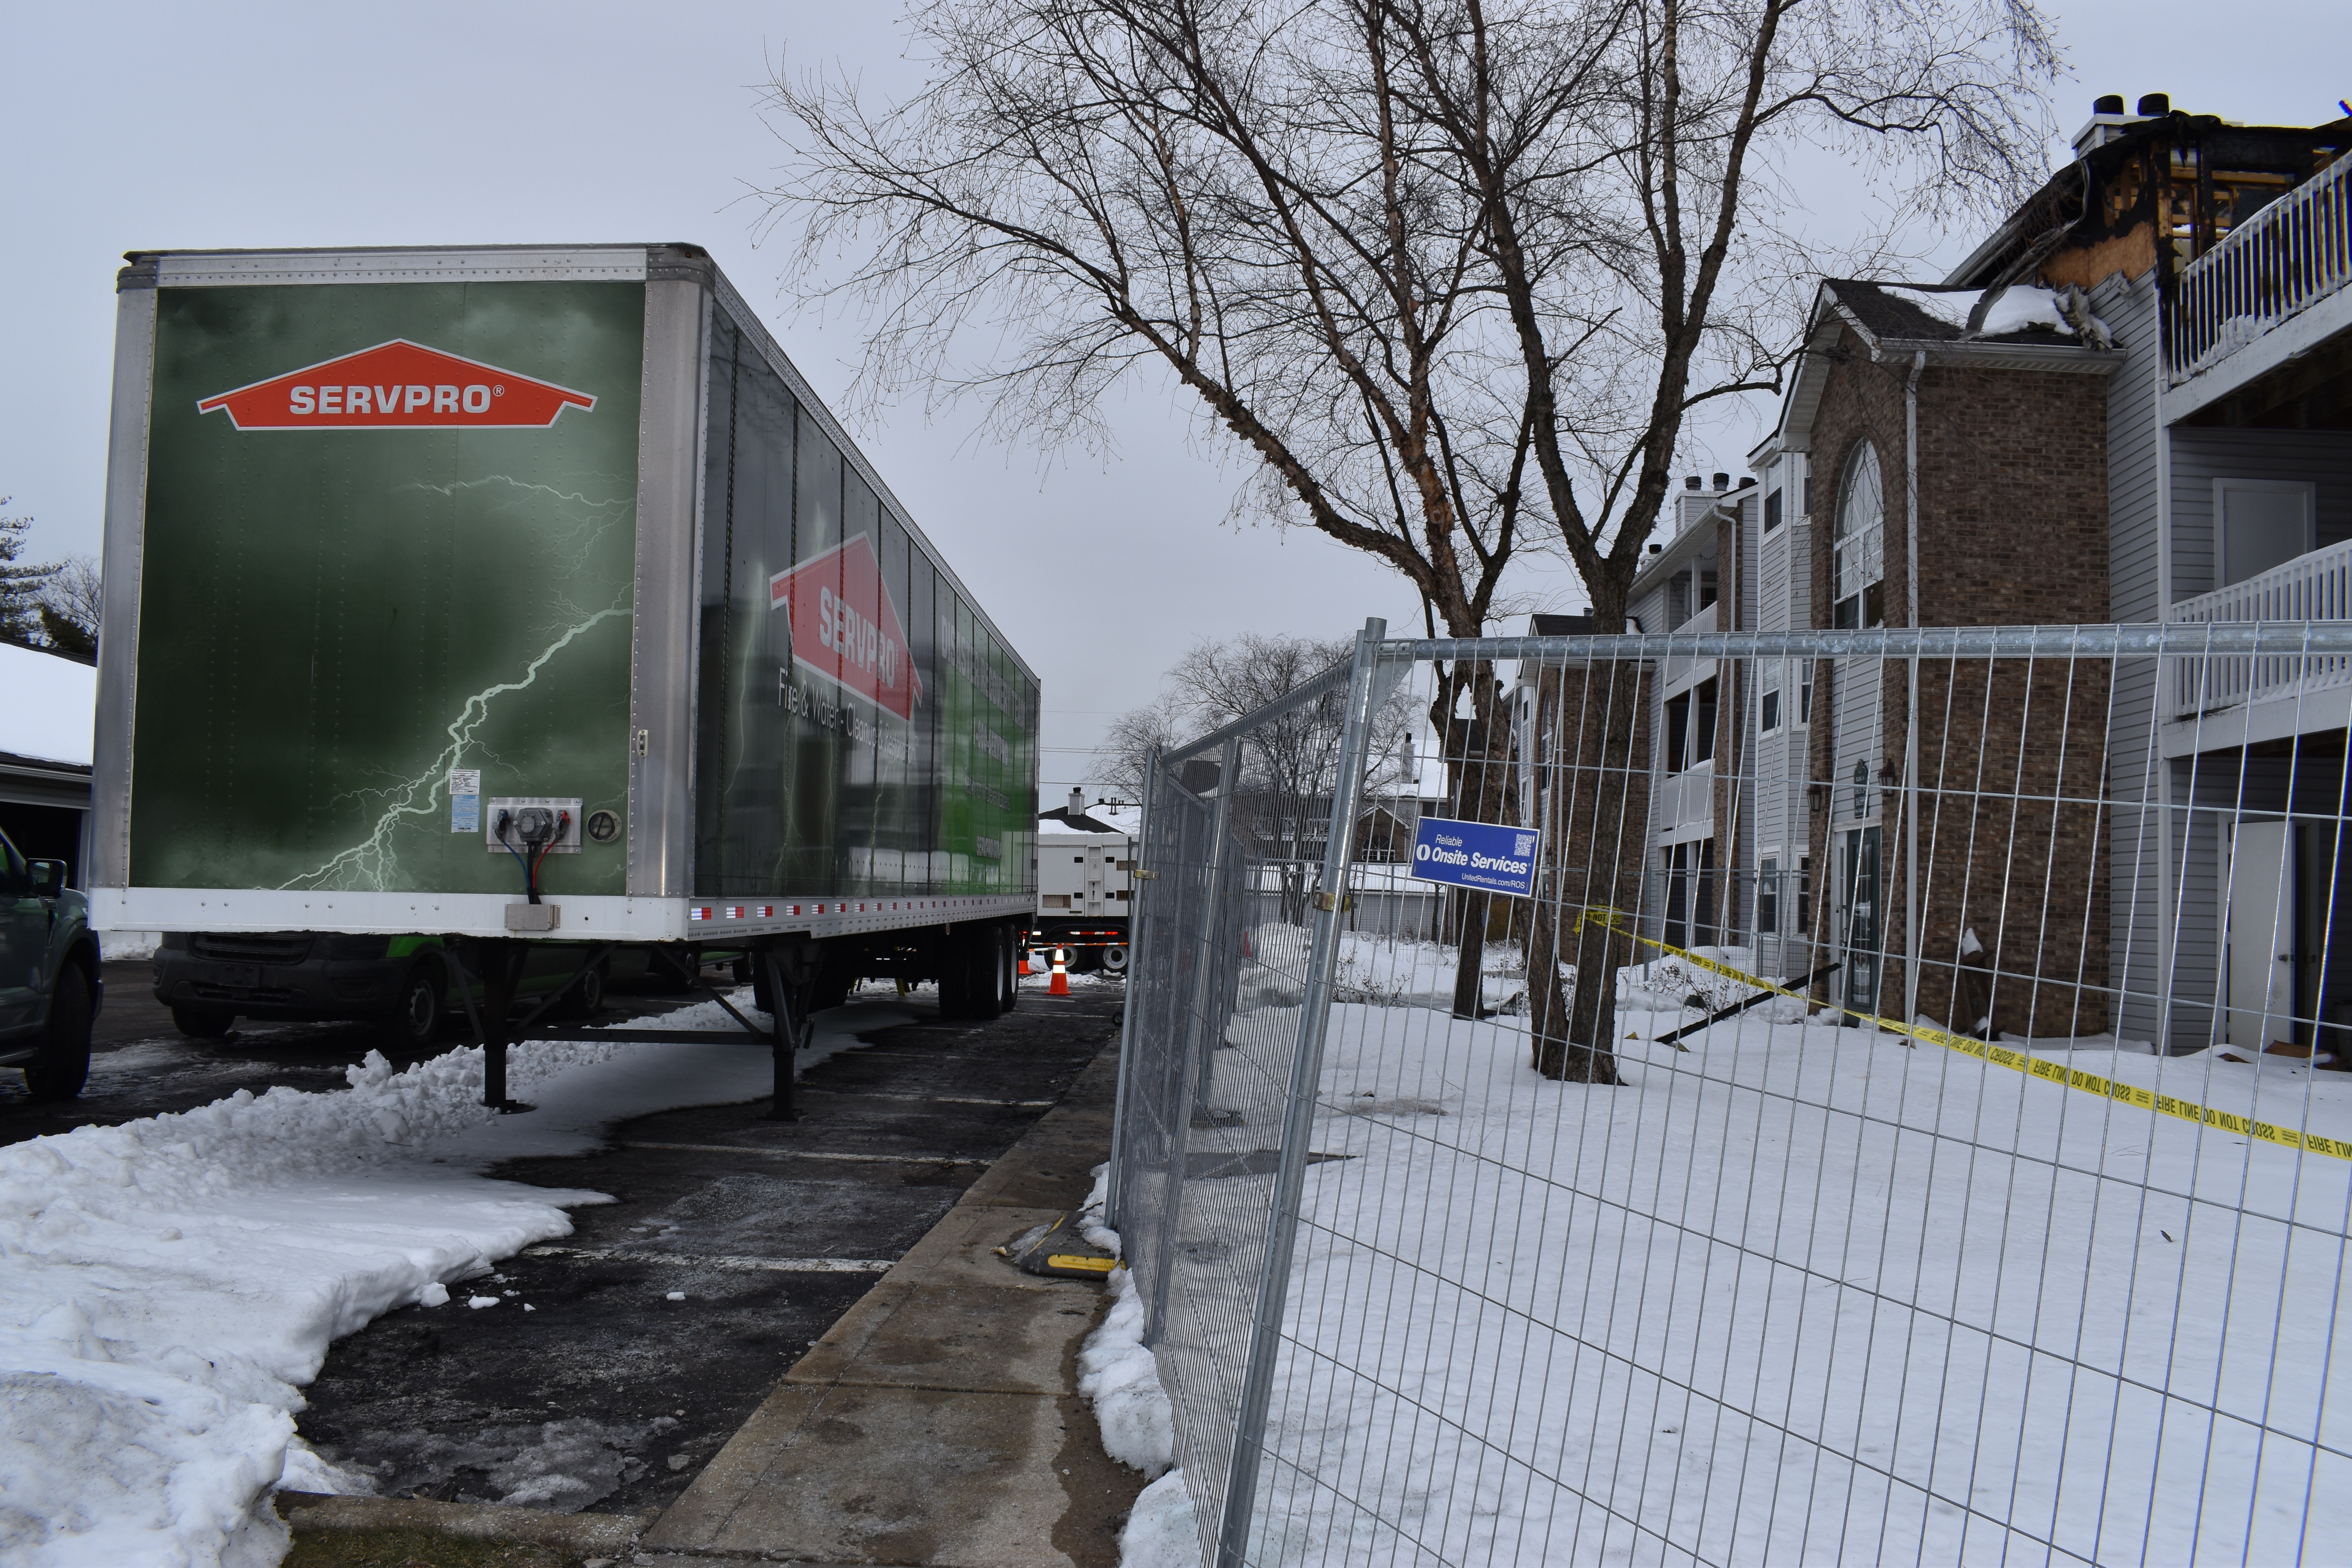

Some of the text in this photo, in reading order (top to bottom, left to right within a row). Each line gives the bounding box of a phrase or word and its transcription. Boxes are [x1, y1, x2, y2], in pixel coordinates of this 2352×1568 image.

[942, 614, 1025, 731] DISASTER RECOVERY TEAM
[779, 667, 798, 713] Fire
[801, 680, 809, 718] &
[812, 683, 839, 730] Water
[846, 702, 877, 756] Cleanup
[878, 720, 884, 750] &
[973, 716, 1008, 766] 1-800-SERVPRO
[1435, 834, 1463, 847] Reliable
[1432, 847, 1468, 866] Onsite
[1461, 873, 1525, 889] UnitedRentals.com/ROS
[1593, 913, 1606, 922] NOT
